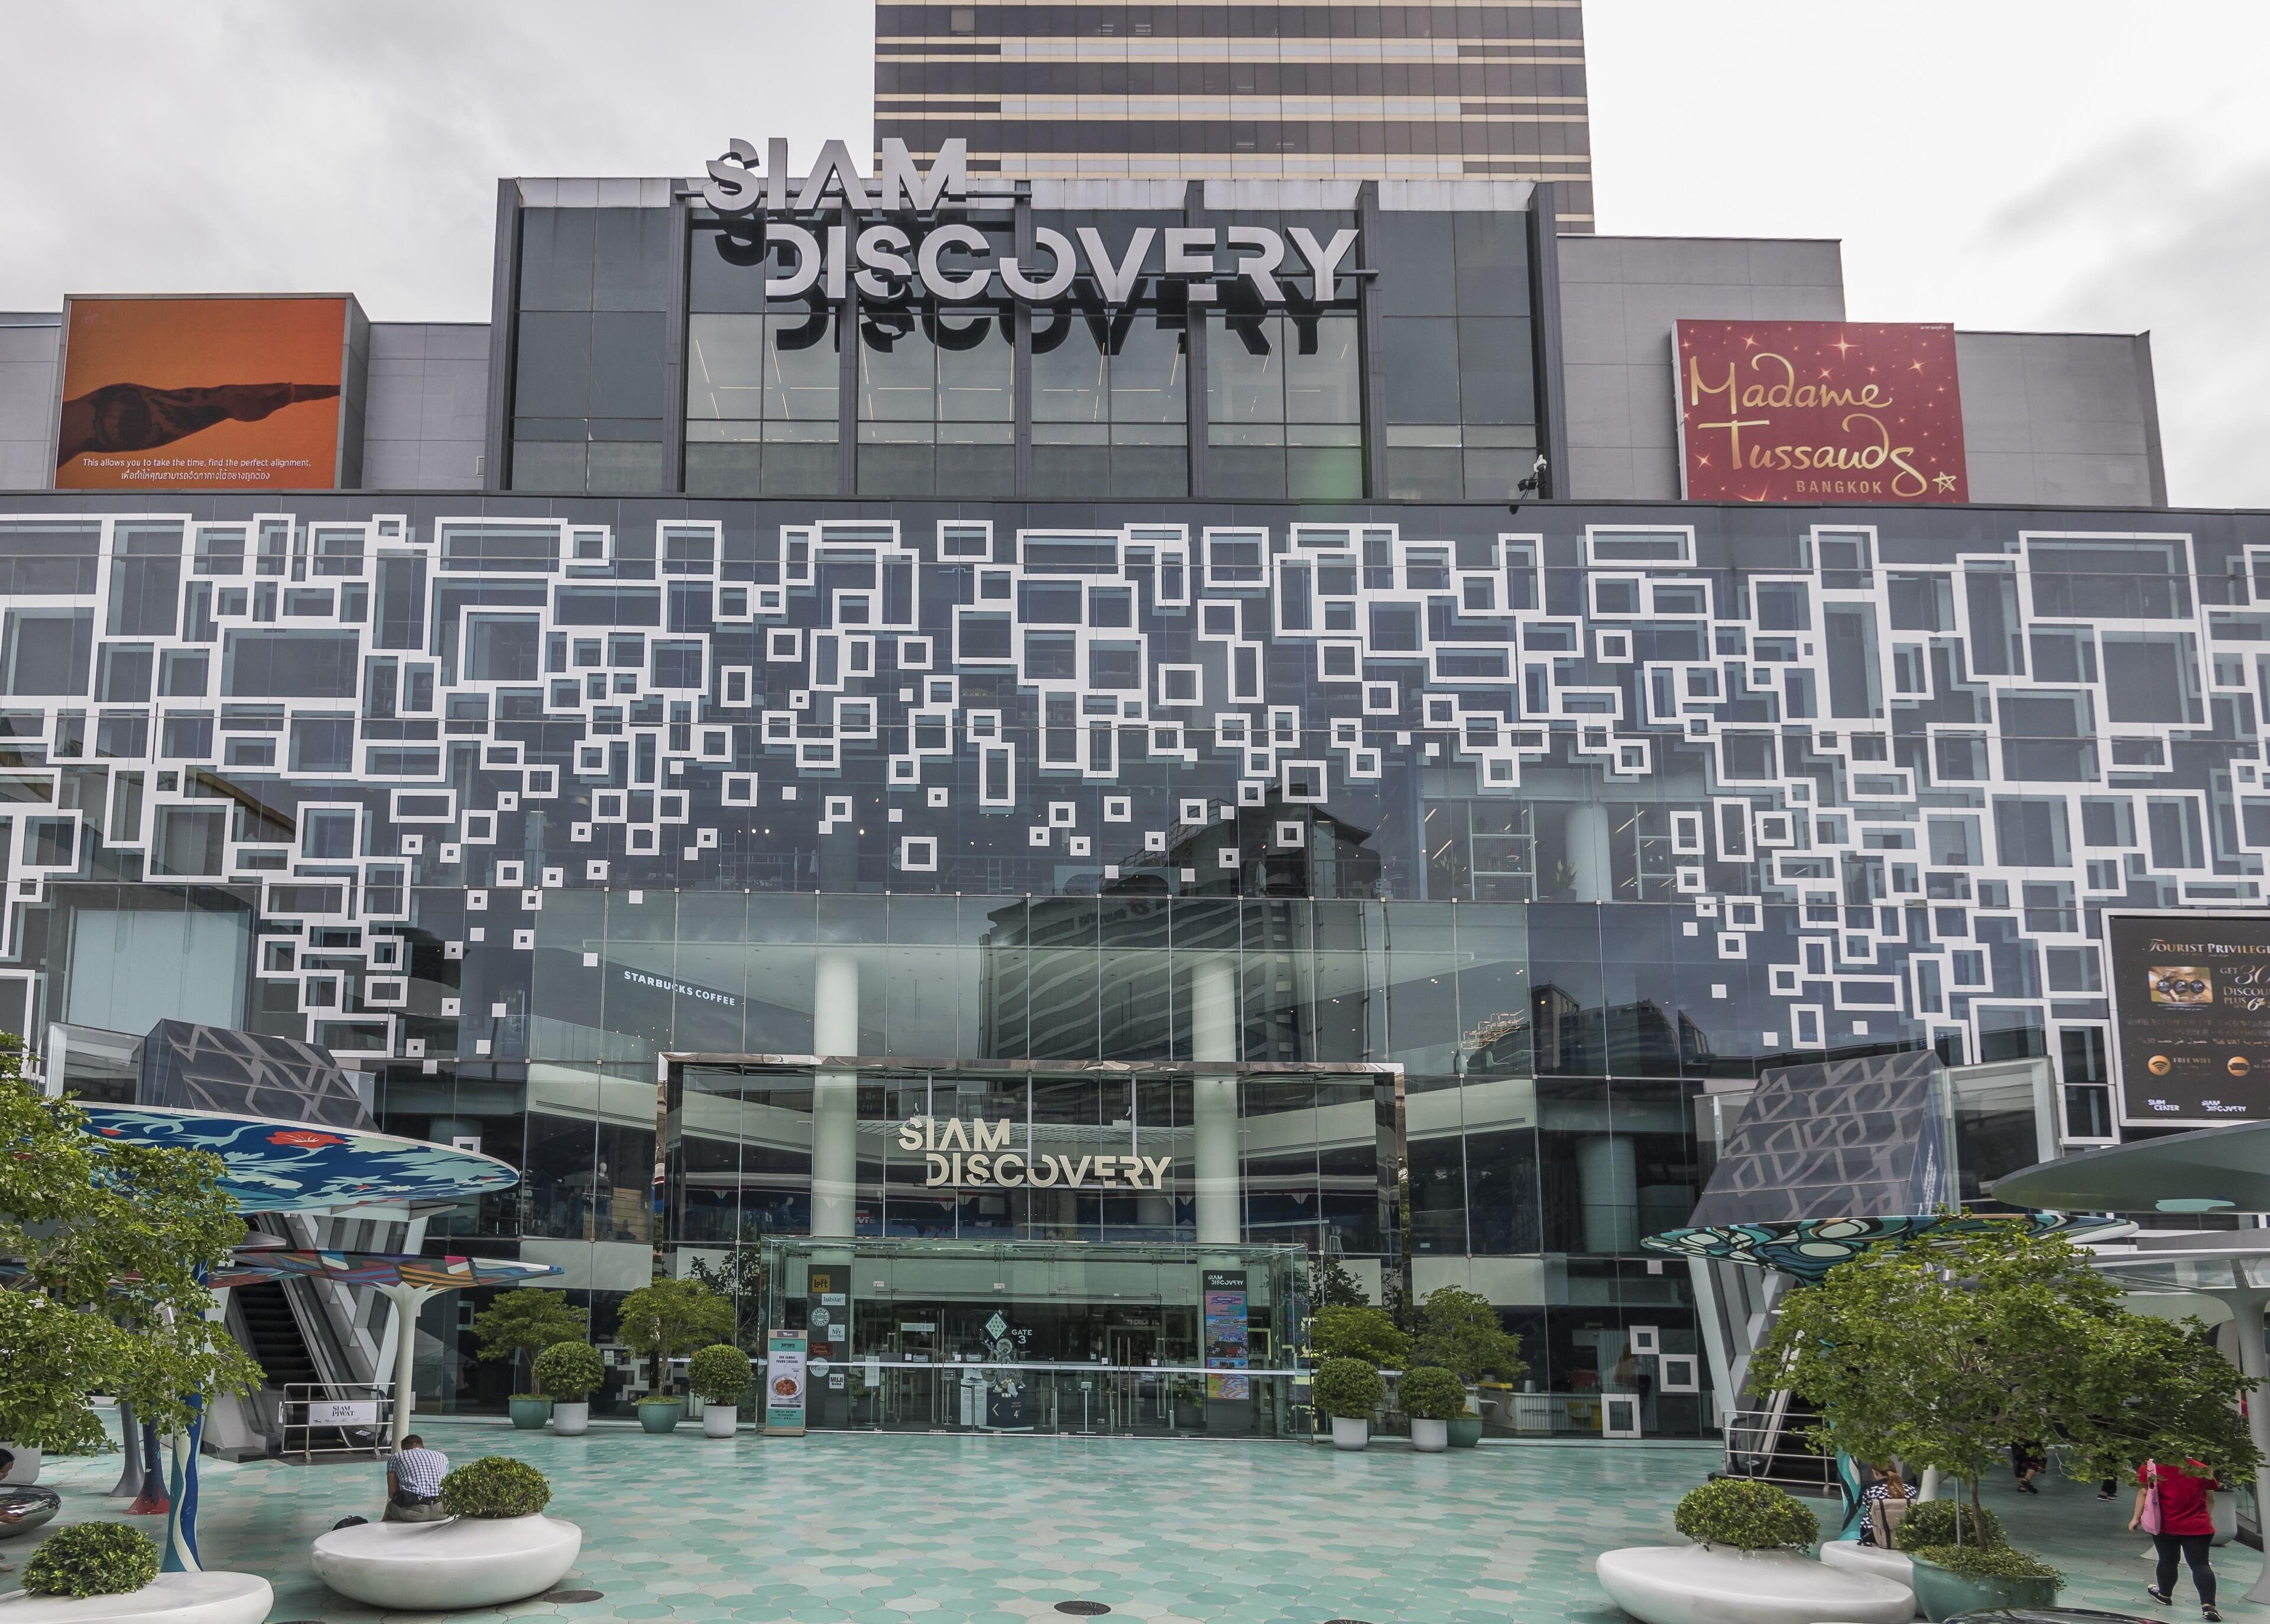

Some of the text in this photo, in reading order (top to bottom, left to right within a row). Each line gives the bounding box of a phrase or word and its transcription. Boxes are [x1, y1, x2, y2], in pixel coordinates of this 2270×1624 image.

[703, 137, 967, 218] SIAM
[764, 224, 1360, 308] DISCOVERY
[1689, 353, 1893, 414] Madame
[187, 459, 206, 467] time,
[241, 459, 268, 467] perfect
[270, 459, 311, 467] alignment.
[1698, 413, 1927, 497] Tussauds
[1796, 480, 1882, 494] BANGKOK
[2149, 938, 2204, 953] TOURIST
[624, 970, 735, 1006] STARBUCKS COFFEE
[2223, 986, 2270, 996] DISCOU
[899, 1117, 1010, 1152] SIAM
[926, 1153, 1172, 1190] DISCOVERY
[1018, 1336, 1026, 1344] 3
